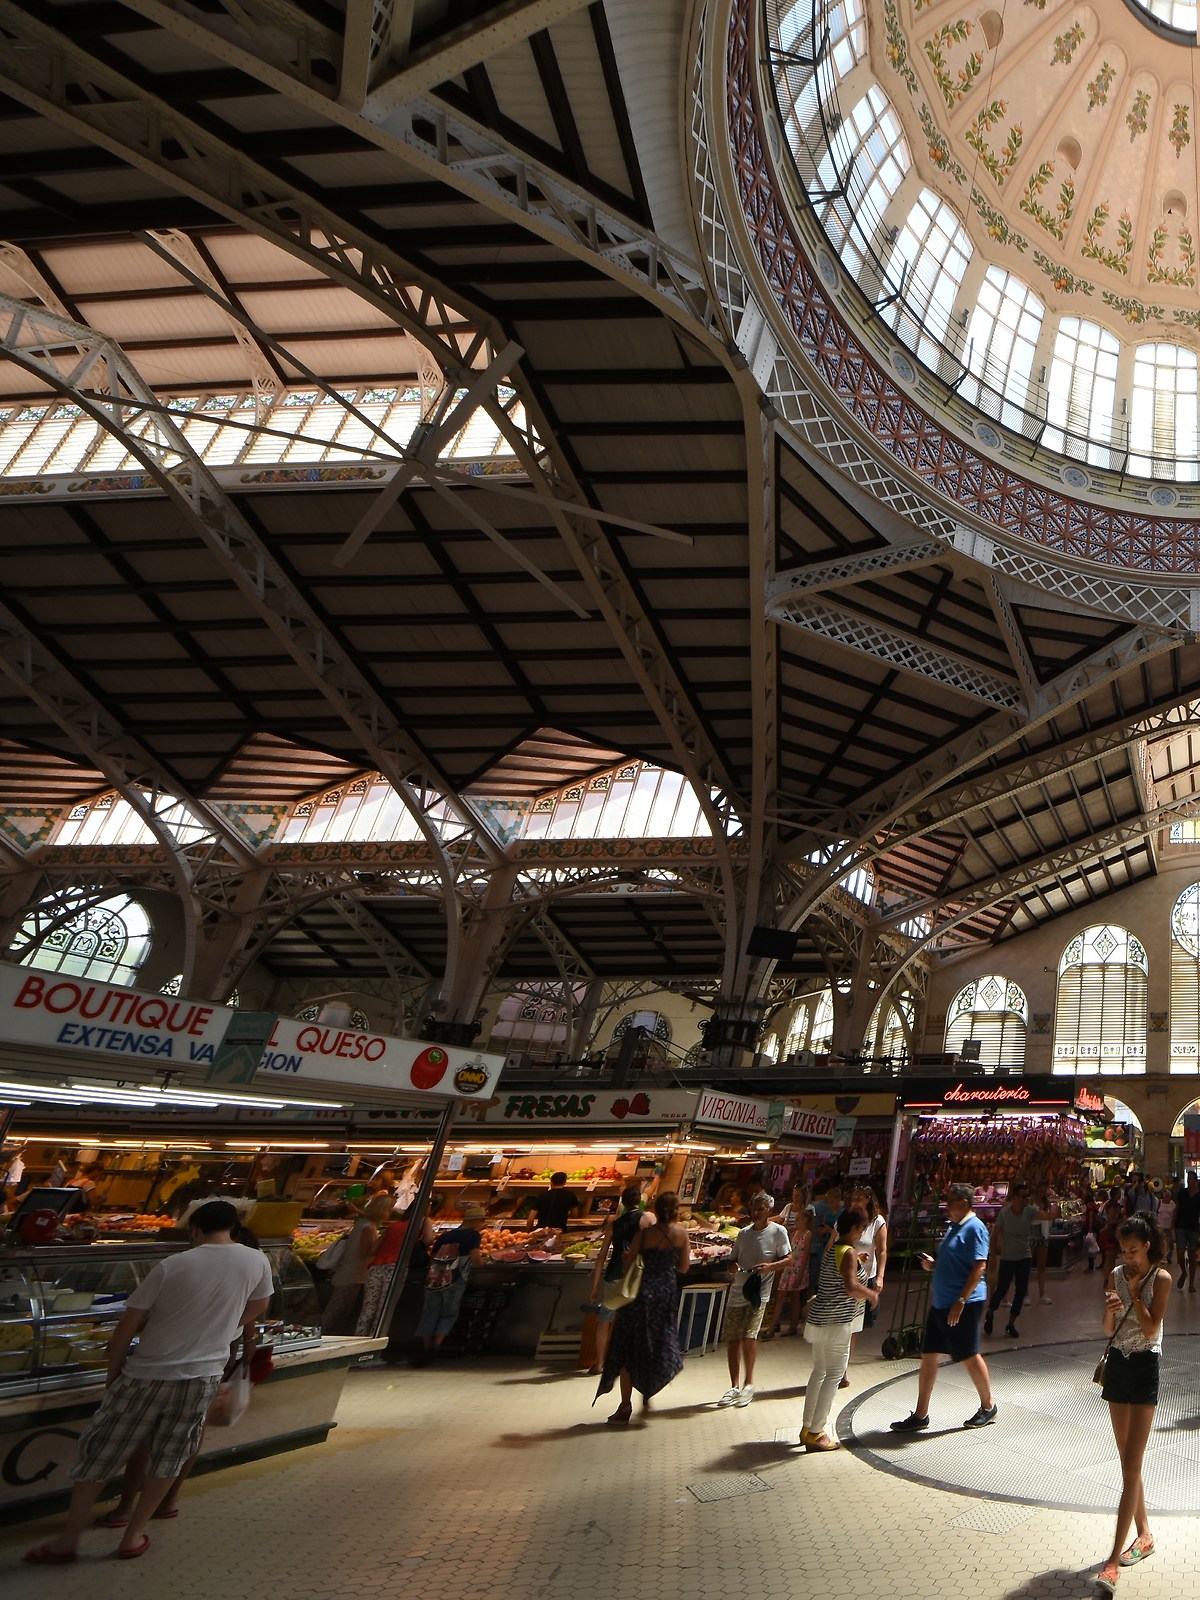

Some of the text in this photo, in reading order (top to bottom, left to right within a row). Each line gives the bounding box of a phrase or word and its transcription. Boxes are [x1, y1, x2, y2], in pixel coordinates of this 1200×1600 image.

[14, 975, 214, 1036] BOUTIQUE
[56, 1022, 173, 1058] EXTENSA
[296, 1026, 386, 1062] QUESO
[503, 1093, 597, 1120] FRESAS
[943, 1083, 1030, 1102] charcutería
[700, 1095, 757, 1124] VIRGINIA
